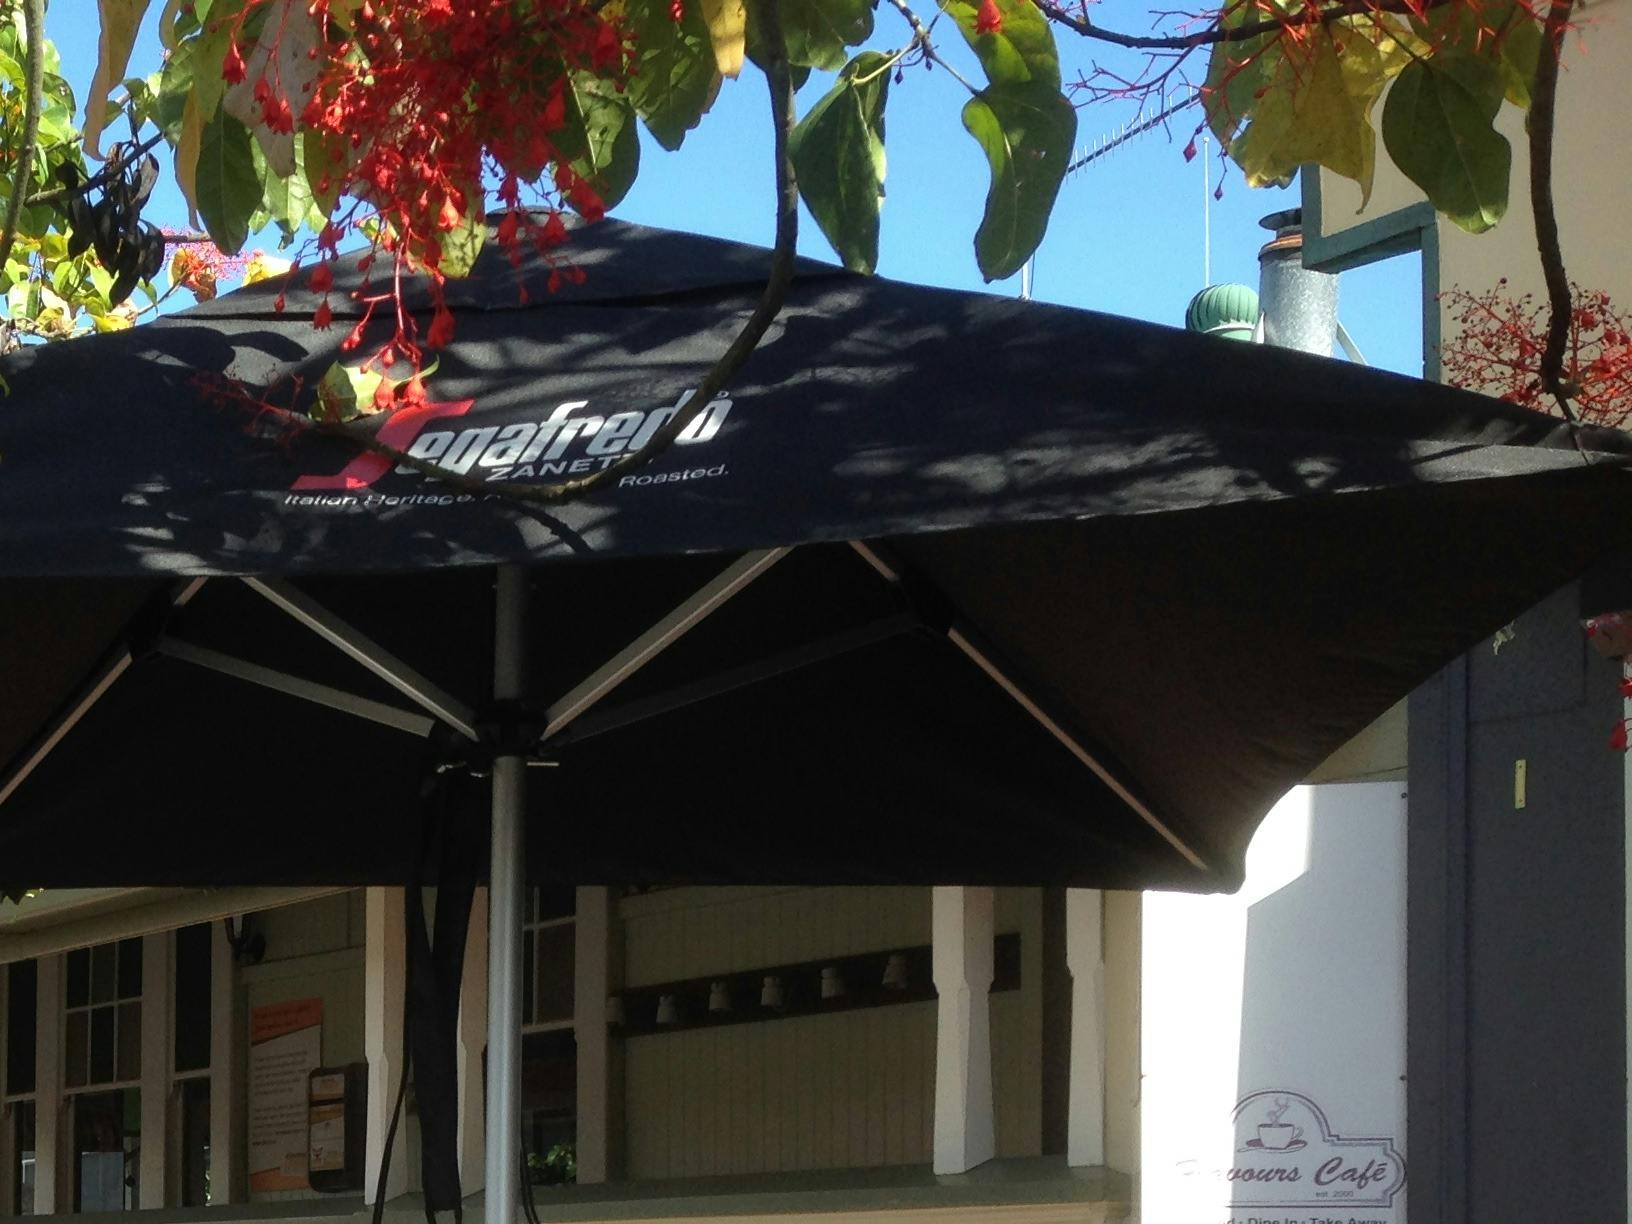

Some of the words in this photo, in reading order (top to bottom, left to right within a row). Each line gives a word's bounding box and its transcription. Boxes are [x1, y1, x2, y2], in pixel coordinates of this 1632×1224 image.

[485, 447, 654, 482] ZANET
[285, 494, 357, 505] Italian
[618, 463, 729, 488] Roasted.
[1176, 1159, 1302, 1182] vours
[1314, 1156, 1388, 1190] Café
